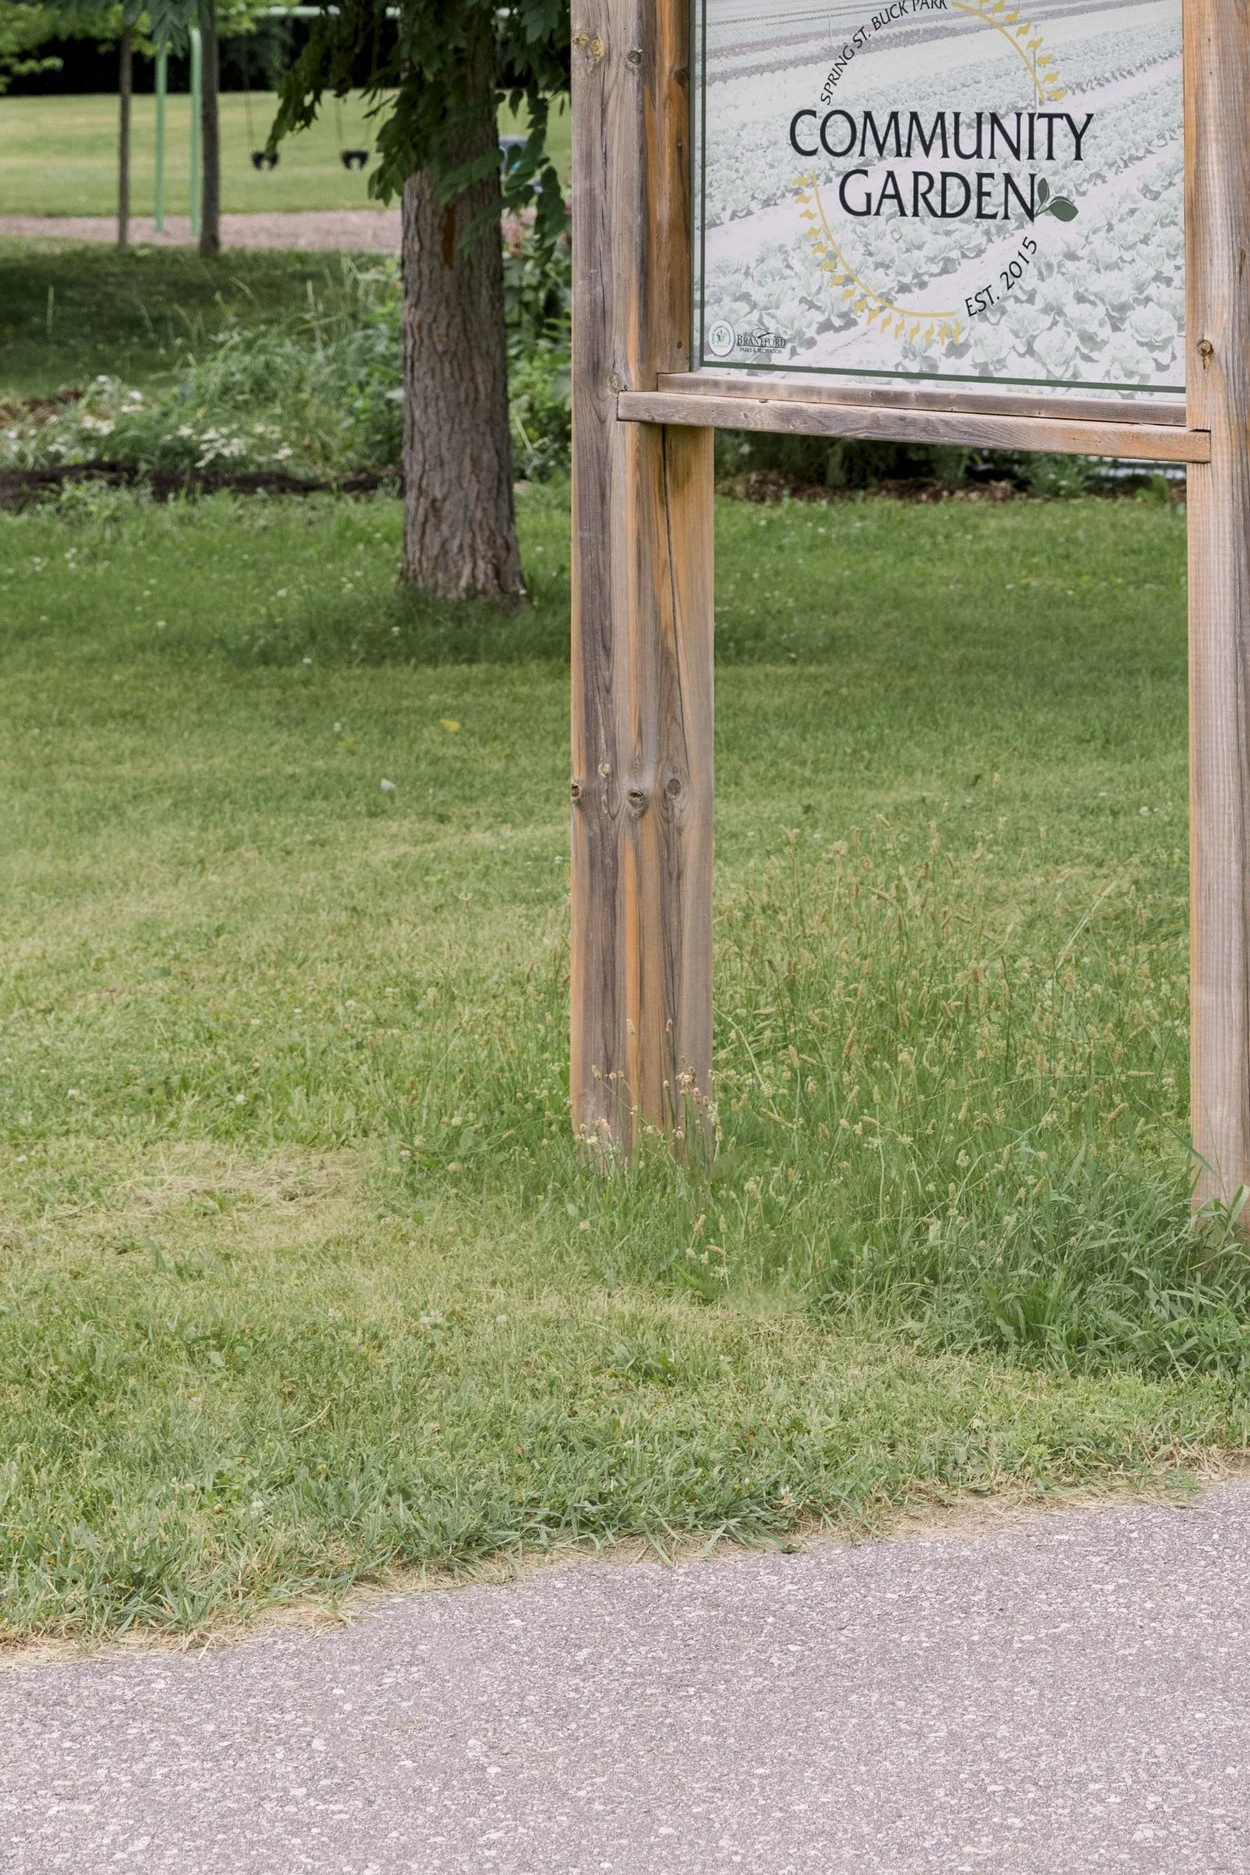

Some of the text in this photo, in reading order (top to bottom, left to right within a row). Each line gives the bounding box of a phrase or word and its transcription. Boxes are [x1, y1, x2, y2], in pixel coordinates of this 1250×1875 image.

[820, 45, 855, 106] SPRING
[852, 27, 872, 49] ST.
[871, 0, 908, 31] BUCK
[789, 109, 1094, 162] COMMUNITY
[838, 169, 1037, 223] GARDEN
[964, 236, 1038, 317] EST. 2015
